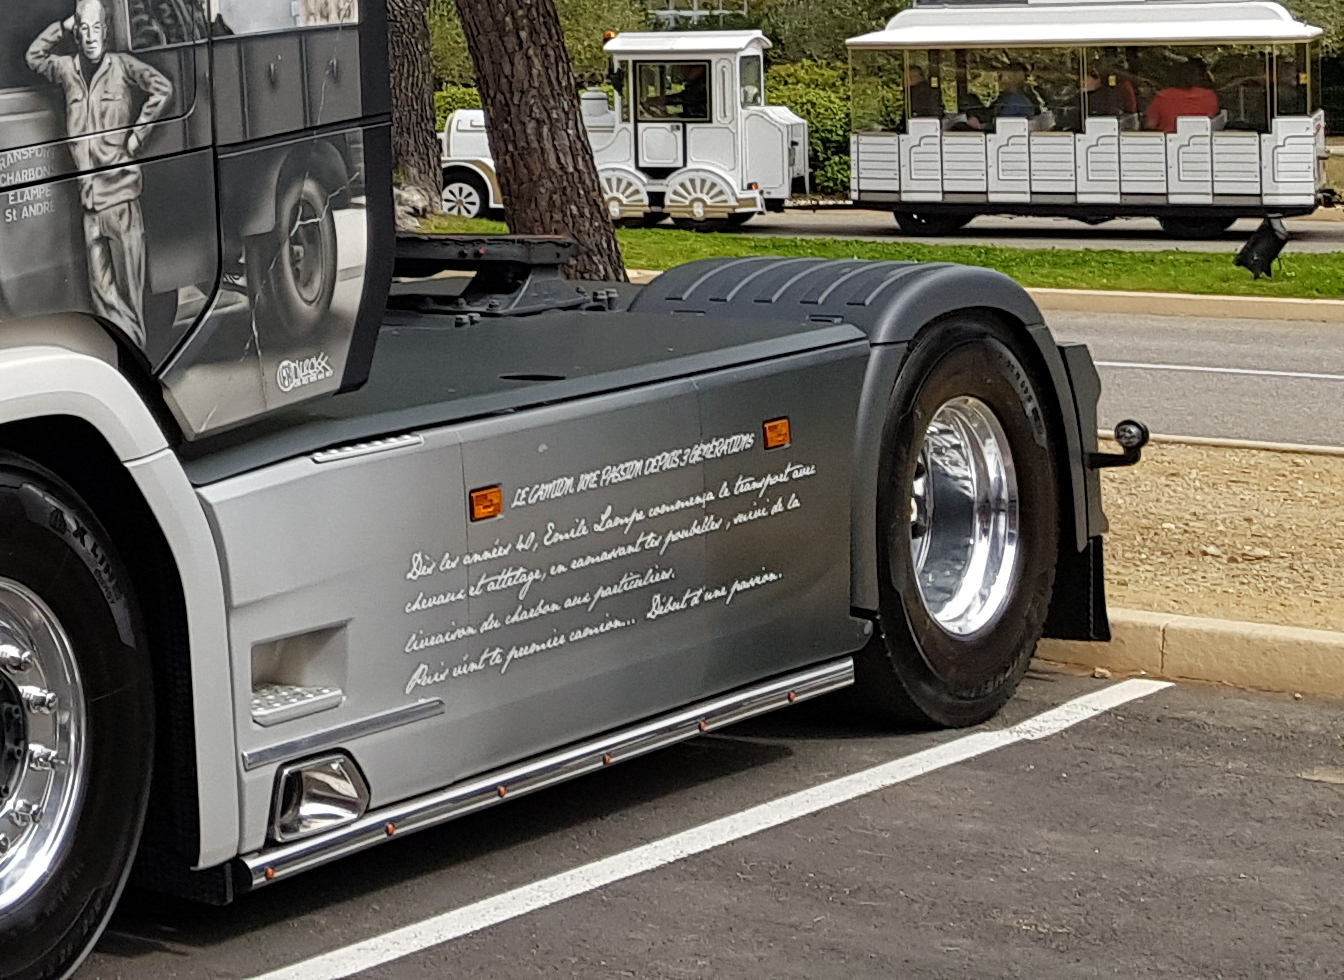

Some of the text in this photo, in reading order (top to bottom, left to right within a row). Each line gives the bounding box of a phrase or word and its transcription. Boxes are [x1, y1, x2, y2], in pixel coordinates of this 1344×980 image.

[439, 553, 459, 571] les
[463, 539, 512, 566] années
[594, 506, 645, 534] Lampe
[719, 482, 730, 498] le
[733, 462, 794, 498] transport
[550, 564, 568, 576] en
[787, 493, 801, 509] la
[480, 613, 500, 633] du
